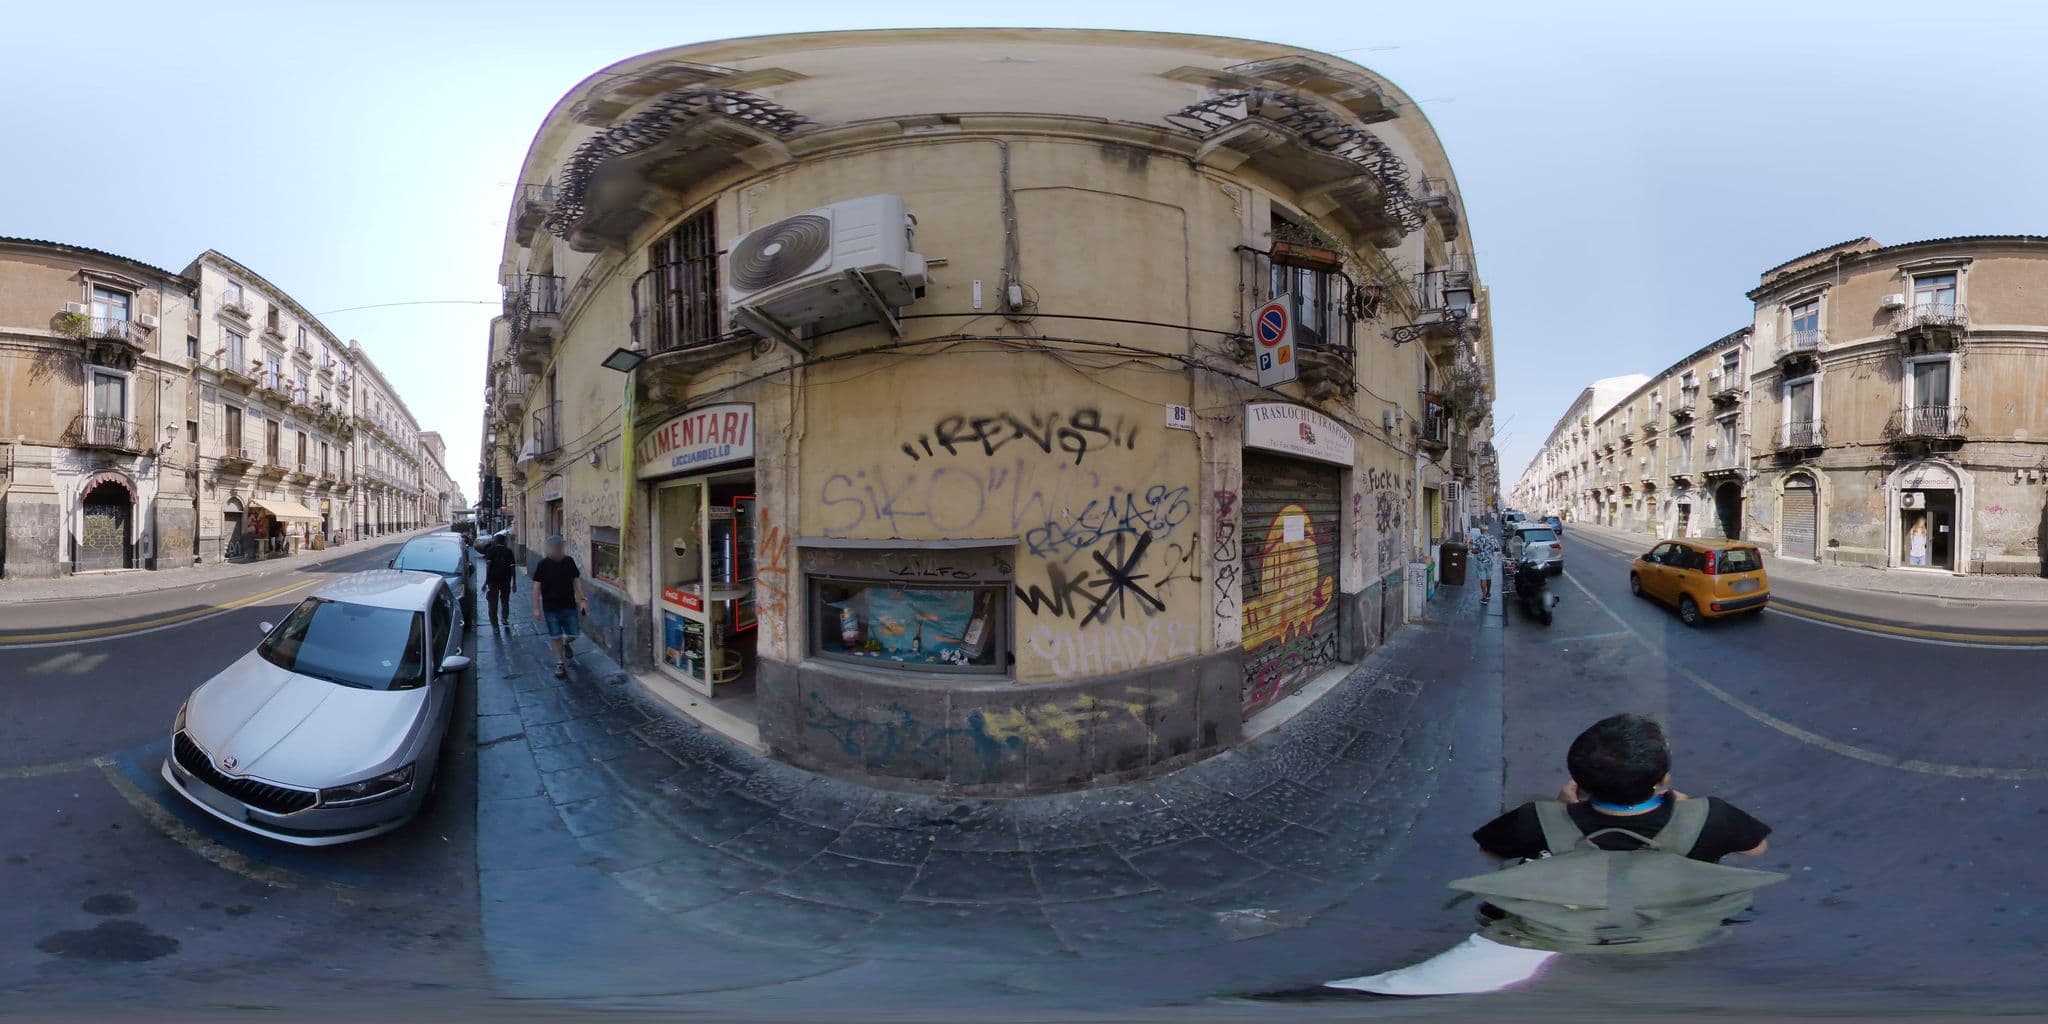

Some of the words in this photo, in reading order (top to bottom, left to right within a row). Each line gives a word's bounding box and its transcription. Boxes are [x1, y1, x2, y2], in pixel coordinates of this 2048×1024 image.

[1174, 406, 1186, 421] 89
[1254, 406, 1311, 420] TRASLOCHI
[1319, 416, 1354, 448] TRASPORTI
[635, 412, 749, 468] ALIMENTARI
[672, 444, 731, 467] LICCIARDELLO
